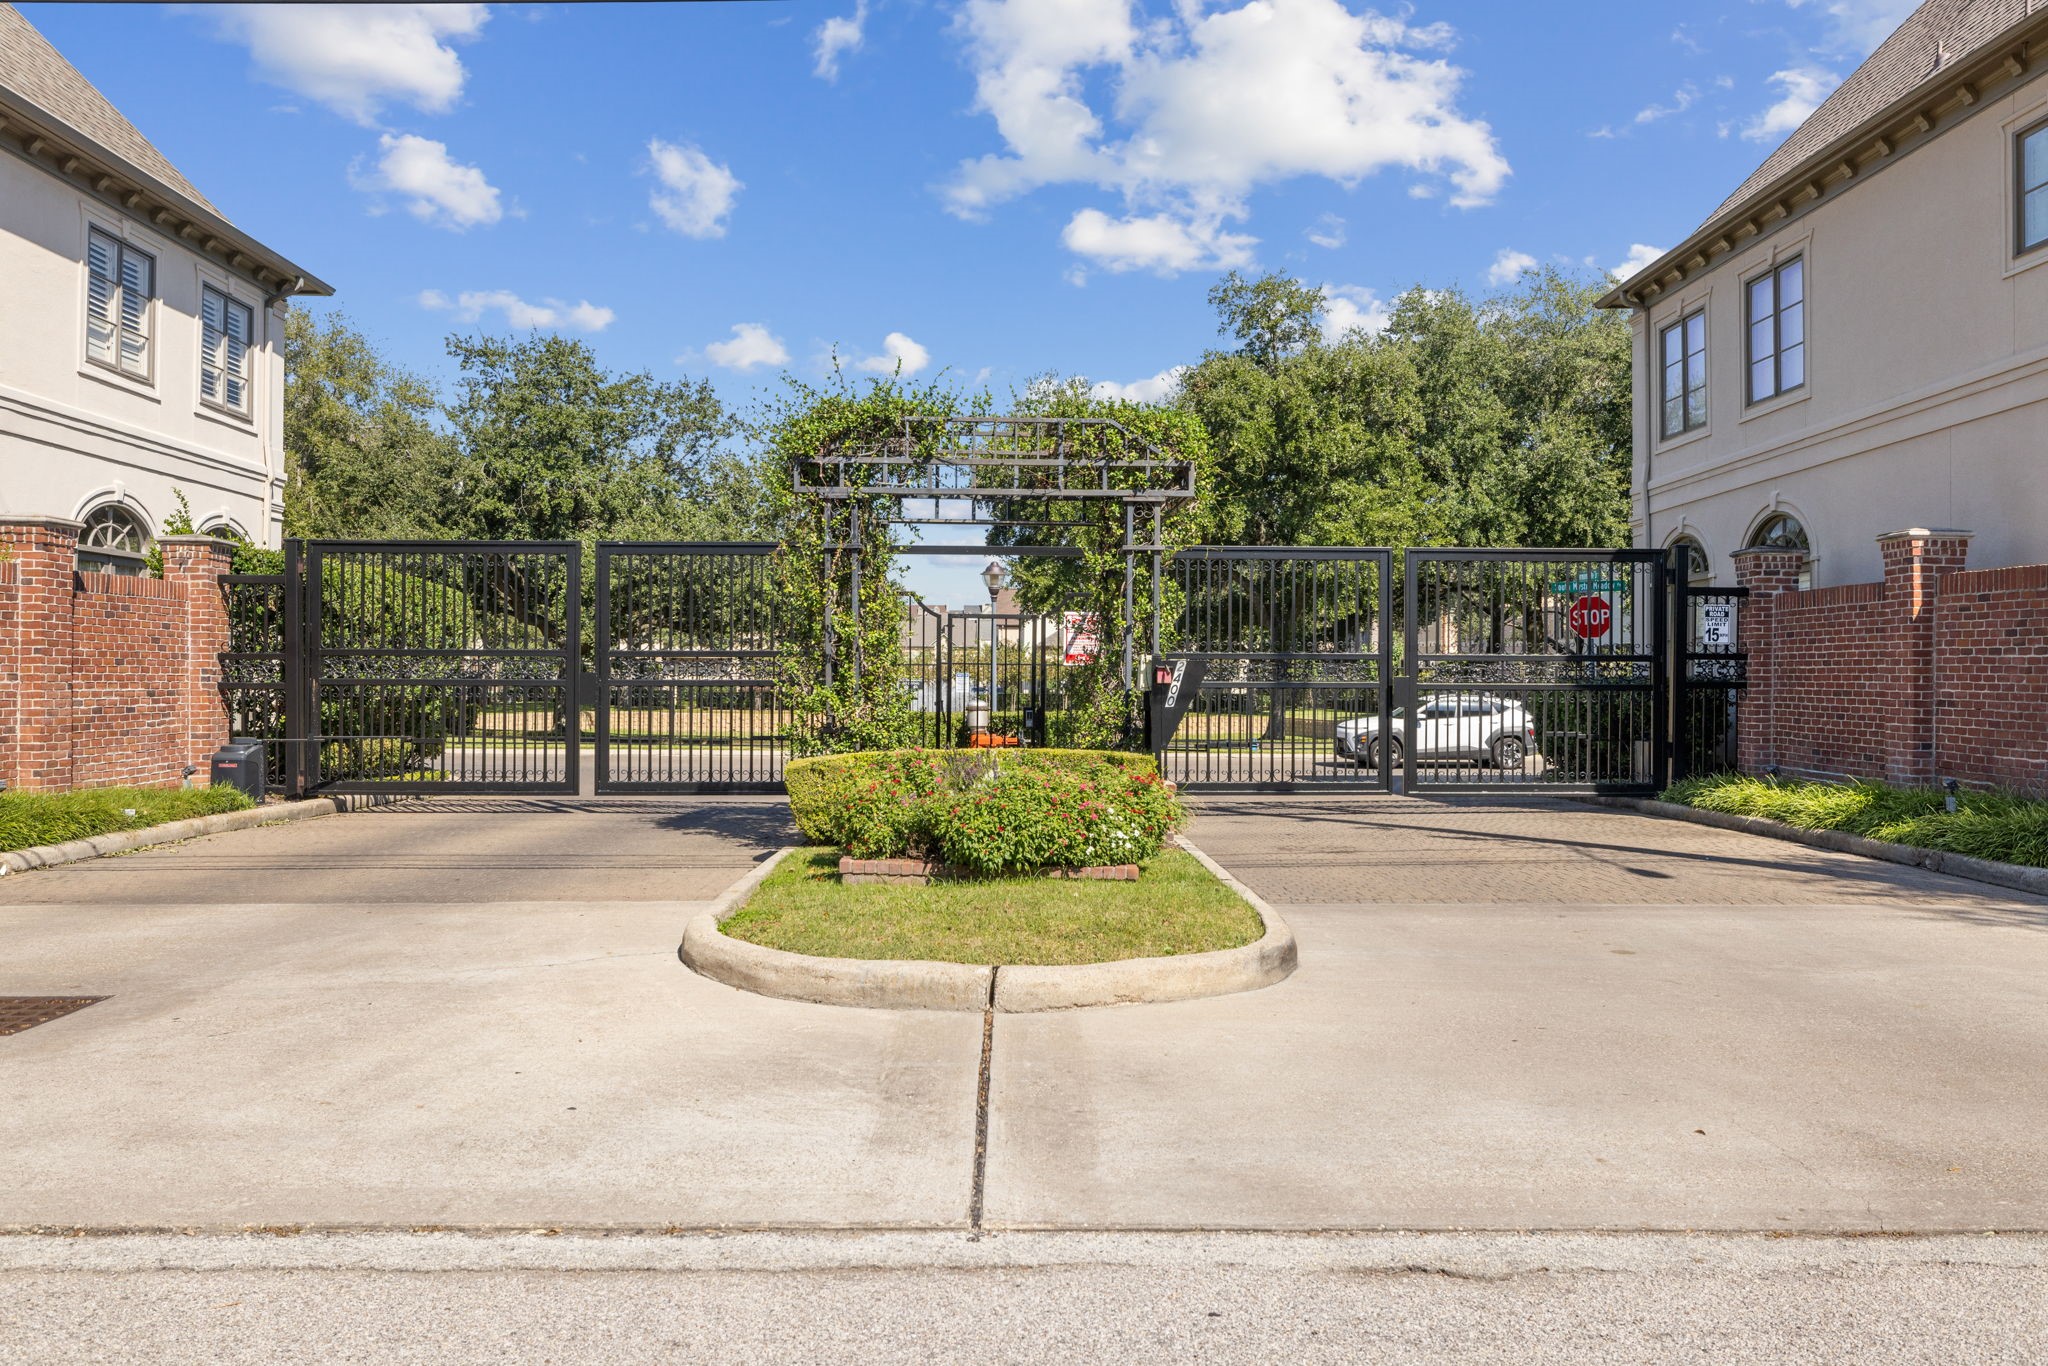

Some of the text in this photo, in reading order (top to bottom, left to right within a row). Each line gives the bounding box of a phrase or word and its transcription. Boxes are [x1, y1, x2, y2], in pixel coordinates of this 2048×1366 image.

[1572, 609, 1610, 626] STOP
[1705, 627, 1720, 642] 15
[1167, 661, 1185, 706] 2400
